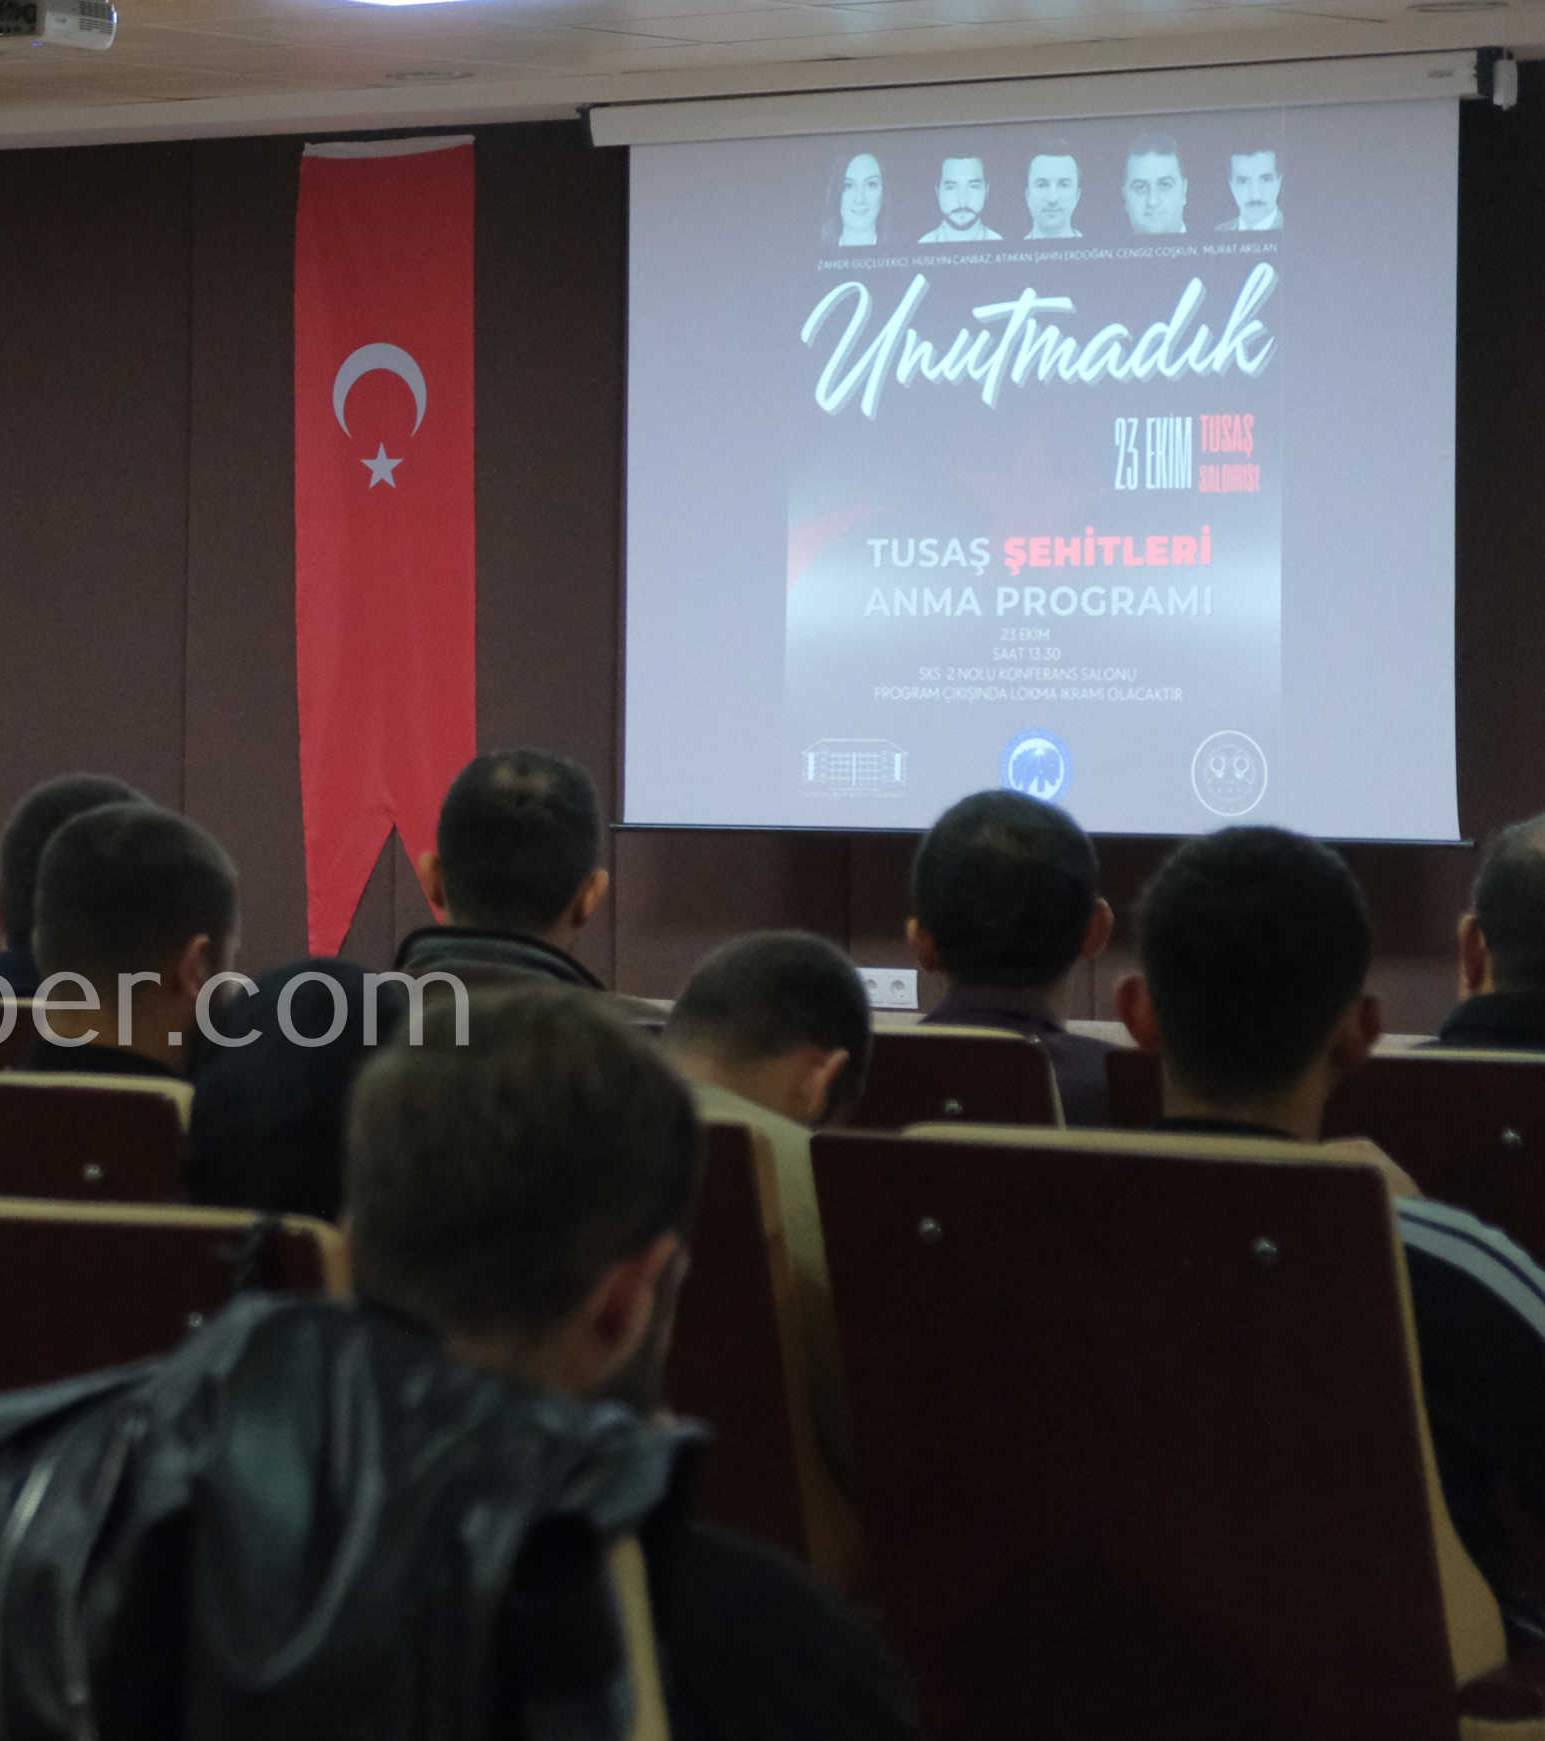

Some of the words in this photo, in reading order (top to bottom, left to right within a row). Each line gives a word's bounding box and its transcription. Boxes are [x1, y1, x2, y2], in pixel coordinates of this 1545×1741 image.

[800, 262, 1276, 418] Unutmadık
[1114, 416, 1139, 490] 23
[1146, 412, 1192, 489] EKİM
[1200, 412, 1254, 459] TUSAŞ
[867, 537, 991, 576] TUSAŞ
[1004, 525, 1212, 576] ŞEHİTLERİ
[863, 587, 982, 617] ANMA
[996, 585, 1213, 617] PROGRAMI
[999, 627, 1016, 641] 23
[992, 647, 1025, 661] SAAT
[957, 667, 996, 681] NOLU
[999, 667, 1078, 681] KONFERANS
[1080, 667, 1138, 682] SALONU
[873, 686, 940, 701] PROGRAM
[1009, 686, 1056, 701] LOKMA
[1108, 686, 1183, 702] OLACAKTIR
